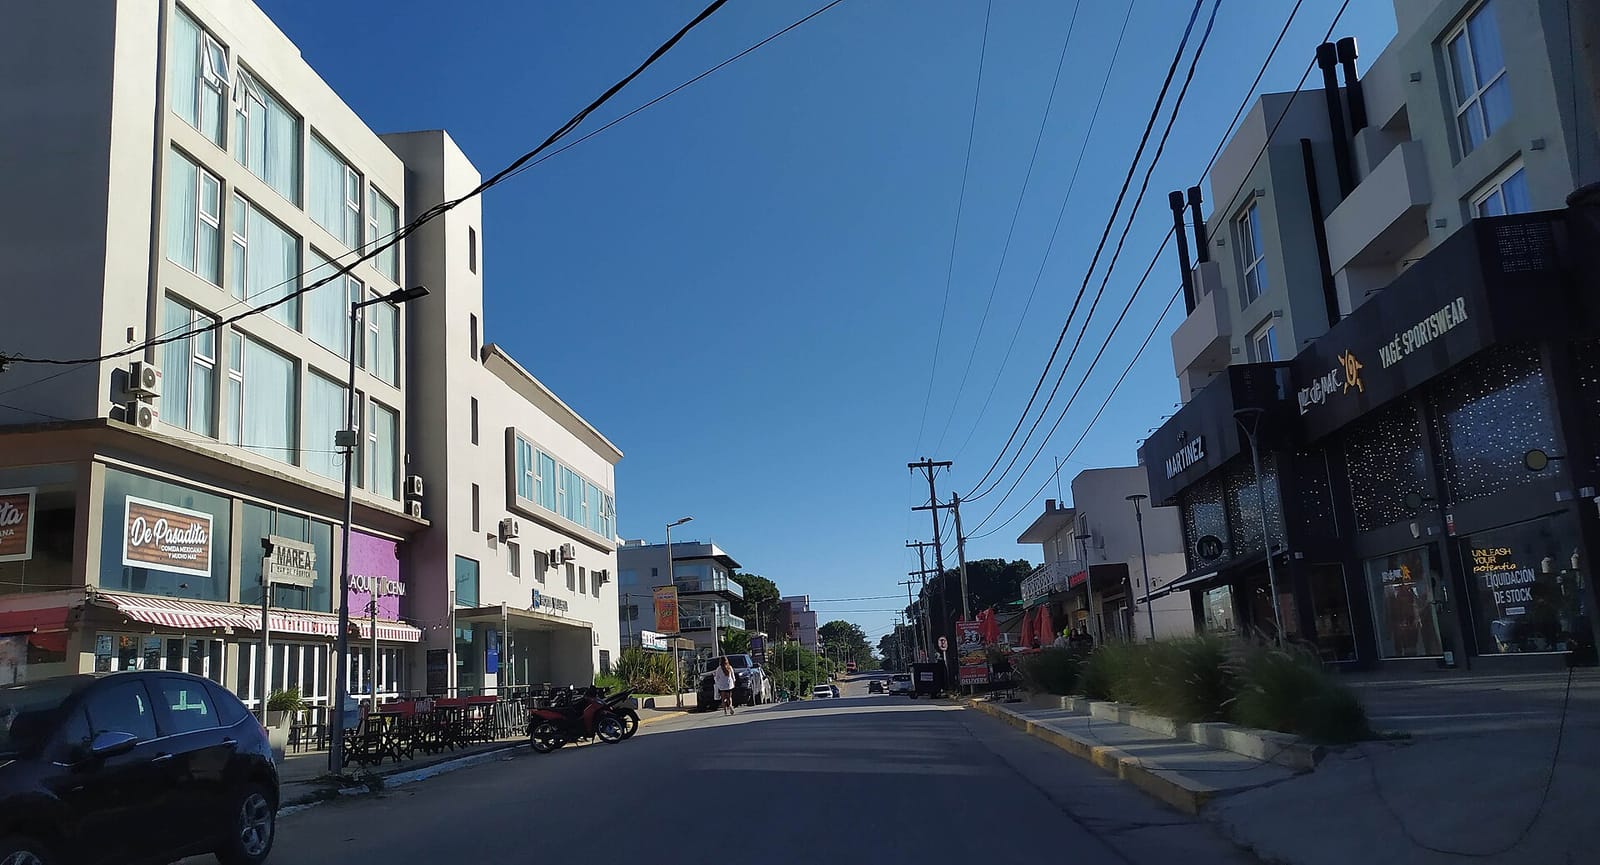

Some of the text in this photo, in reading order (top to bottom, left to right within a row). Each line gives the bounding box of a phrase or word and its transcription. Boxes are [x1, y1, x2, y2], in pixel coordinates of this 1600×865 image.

[1379, 297, 1468, 369] YAGÉ SPORTSWEAR
[1165, 436, 1204, 480] MARTINEZ
[131, 517, 208, 547] De Pasadita
[160, 545, 203, 554] COMIDA MEXICANA
[276, 546, 312, 571] MAREA
[1472, 547, 1511, 557] UNLEASH
[1474, 556, 1497, 564] YOUR
[1485, 565, 1536, 588] LIQUIDACIÓN
[1493, 587, 1533, 604] DE STOCK
